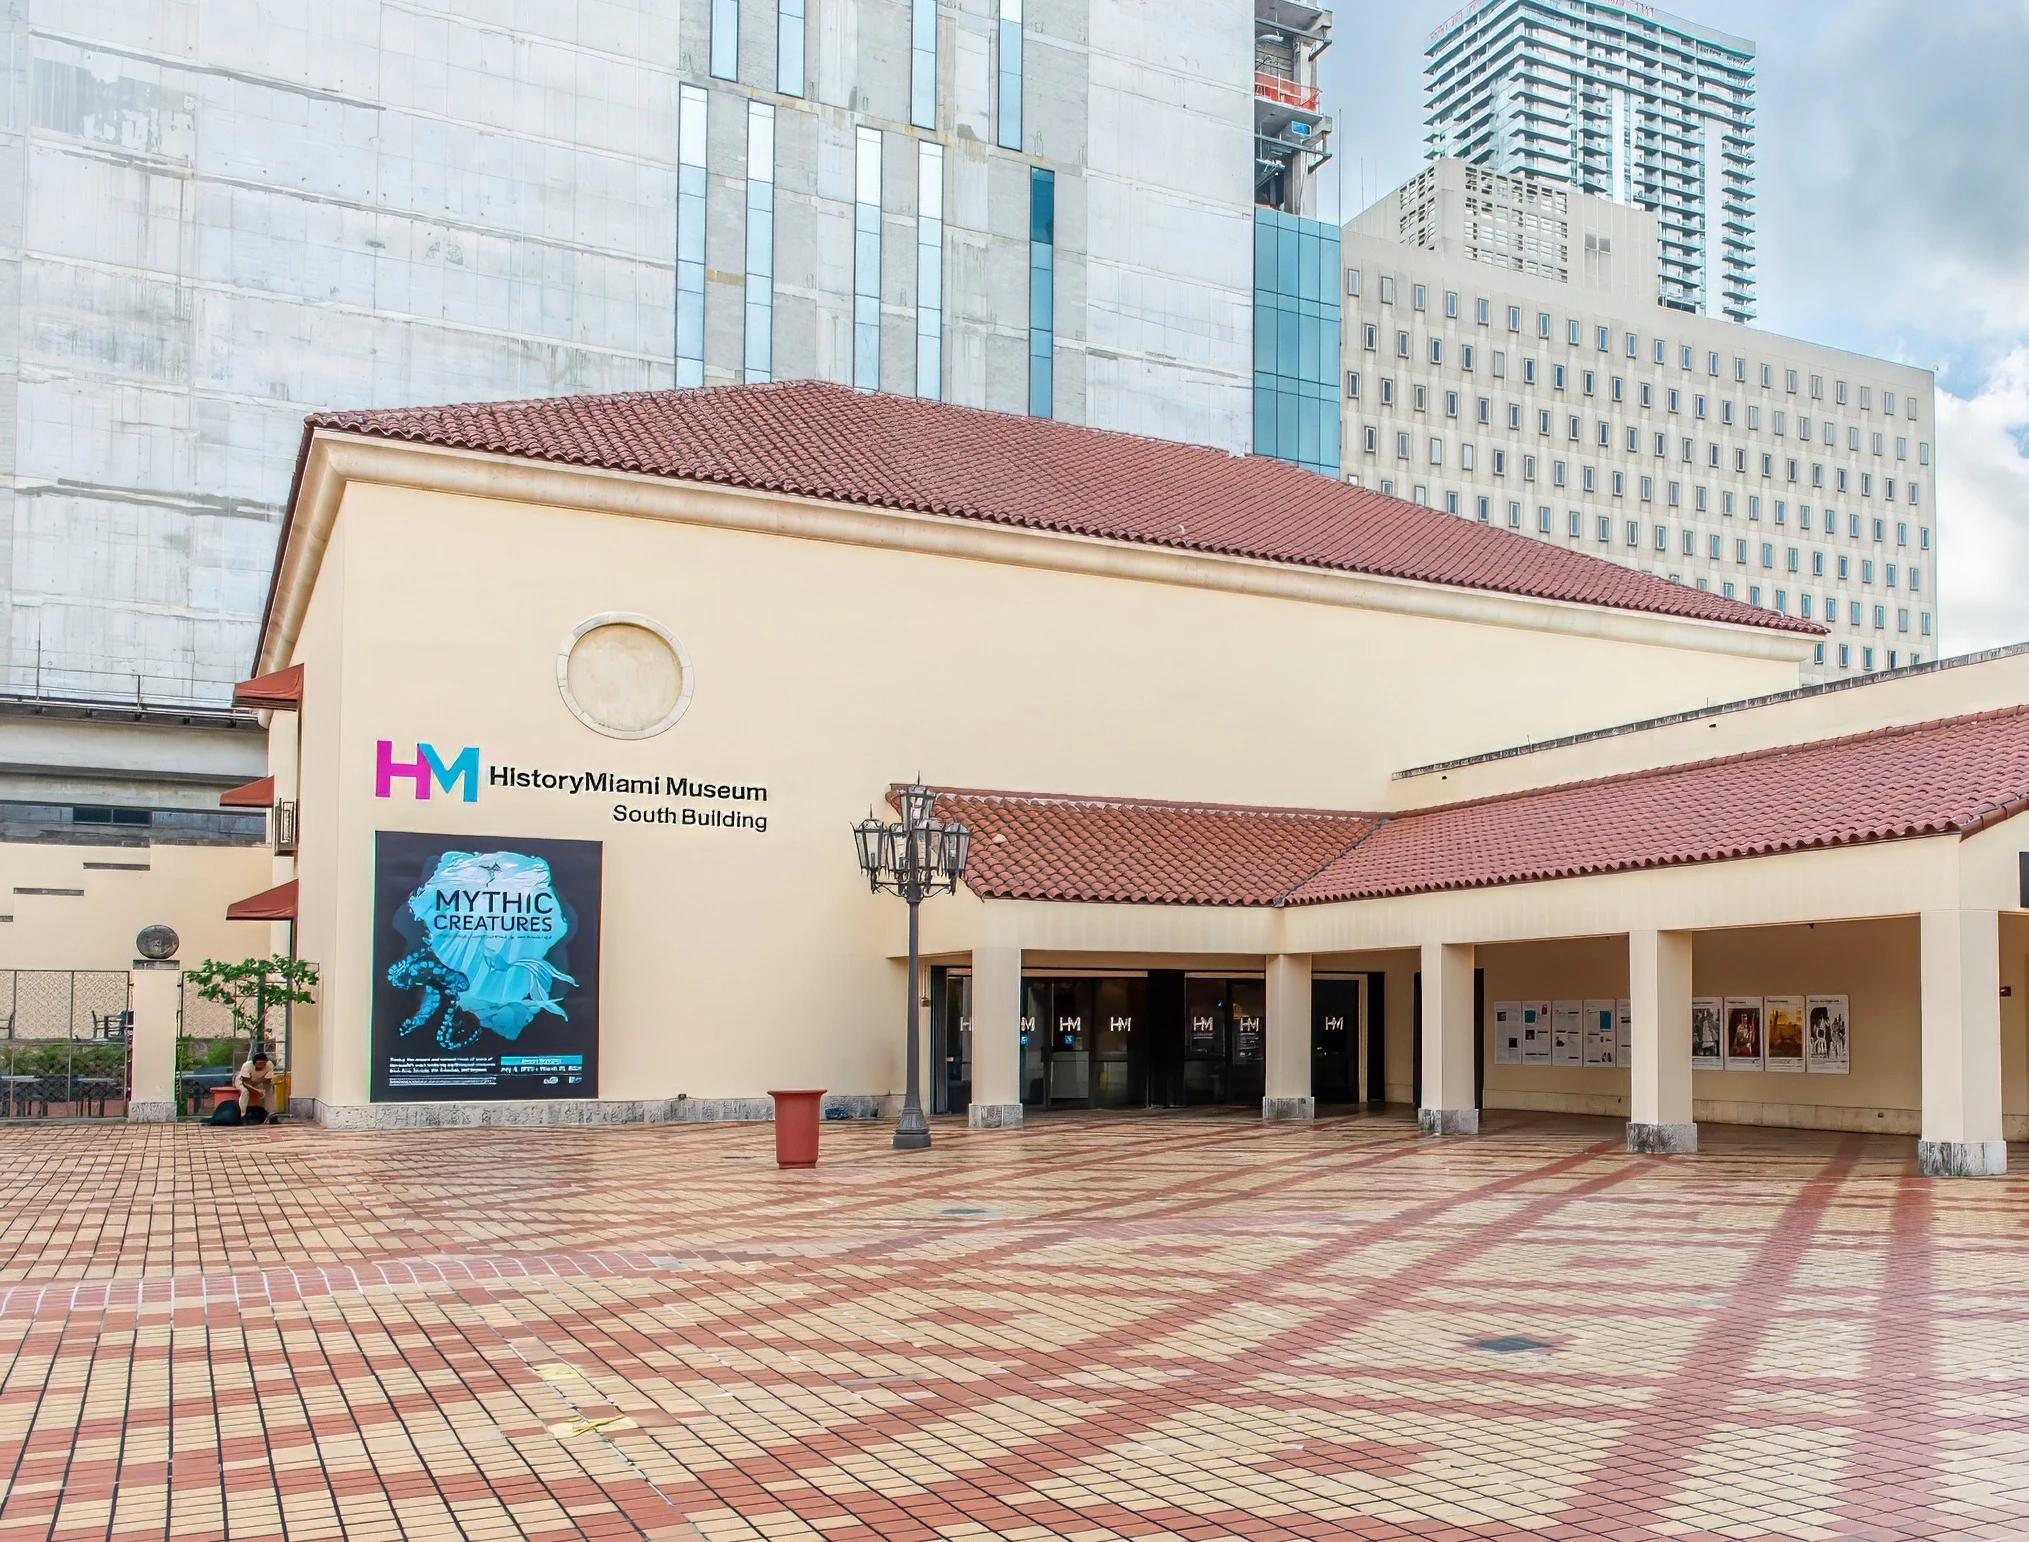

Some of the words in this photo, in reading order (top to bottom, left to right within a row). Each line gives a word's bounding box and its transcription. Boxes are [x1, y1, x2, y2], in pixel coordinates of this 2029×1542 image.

[375, 740, 480, 803] HM
[489, 765, 660, 795] HistoryMiami
[666, 777, 768, 802] Museum
[613, 805, 677, 825] South
[682, 809, 768, 832] Building
[435, 889, 553, 915] MYTHIC
[434, 914, 553, 932] CREATURES
[960, 1016, 972, 1031] H
[1021, 1016, 1036, 1032] M
[1059, 1016, 1081, 1032] HM
[1110, 1016, 1132, 1032] HM
[1193, 1016, 1214, 1031] HM
[1240, 1017, 1260, 1032] HM
[1325, 1016, 1344, 1031] HM
